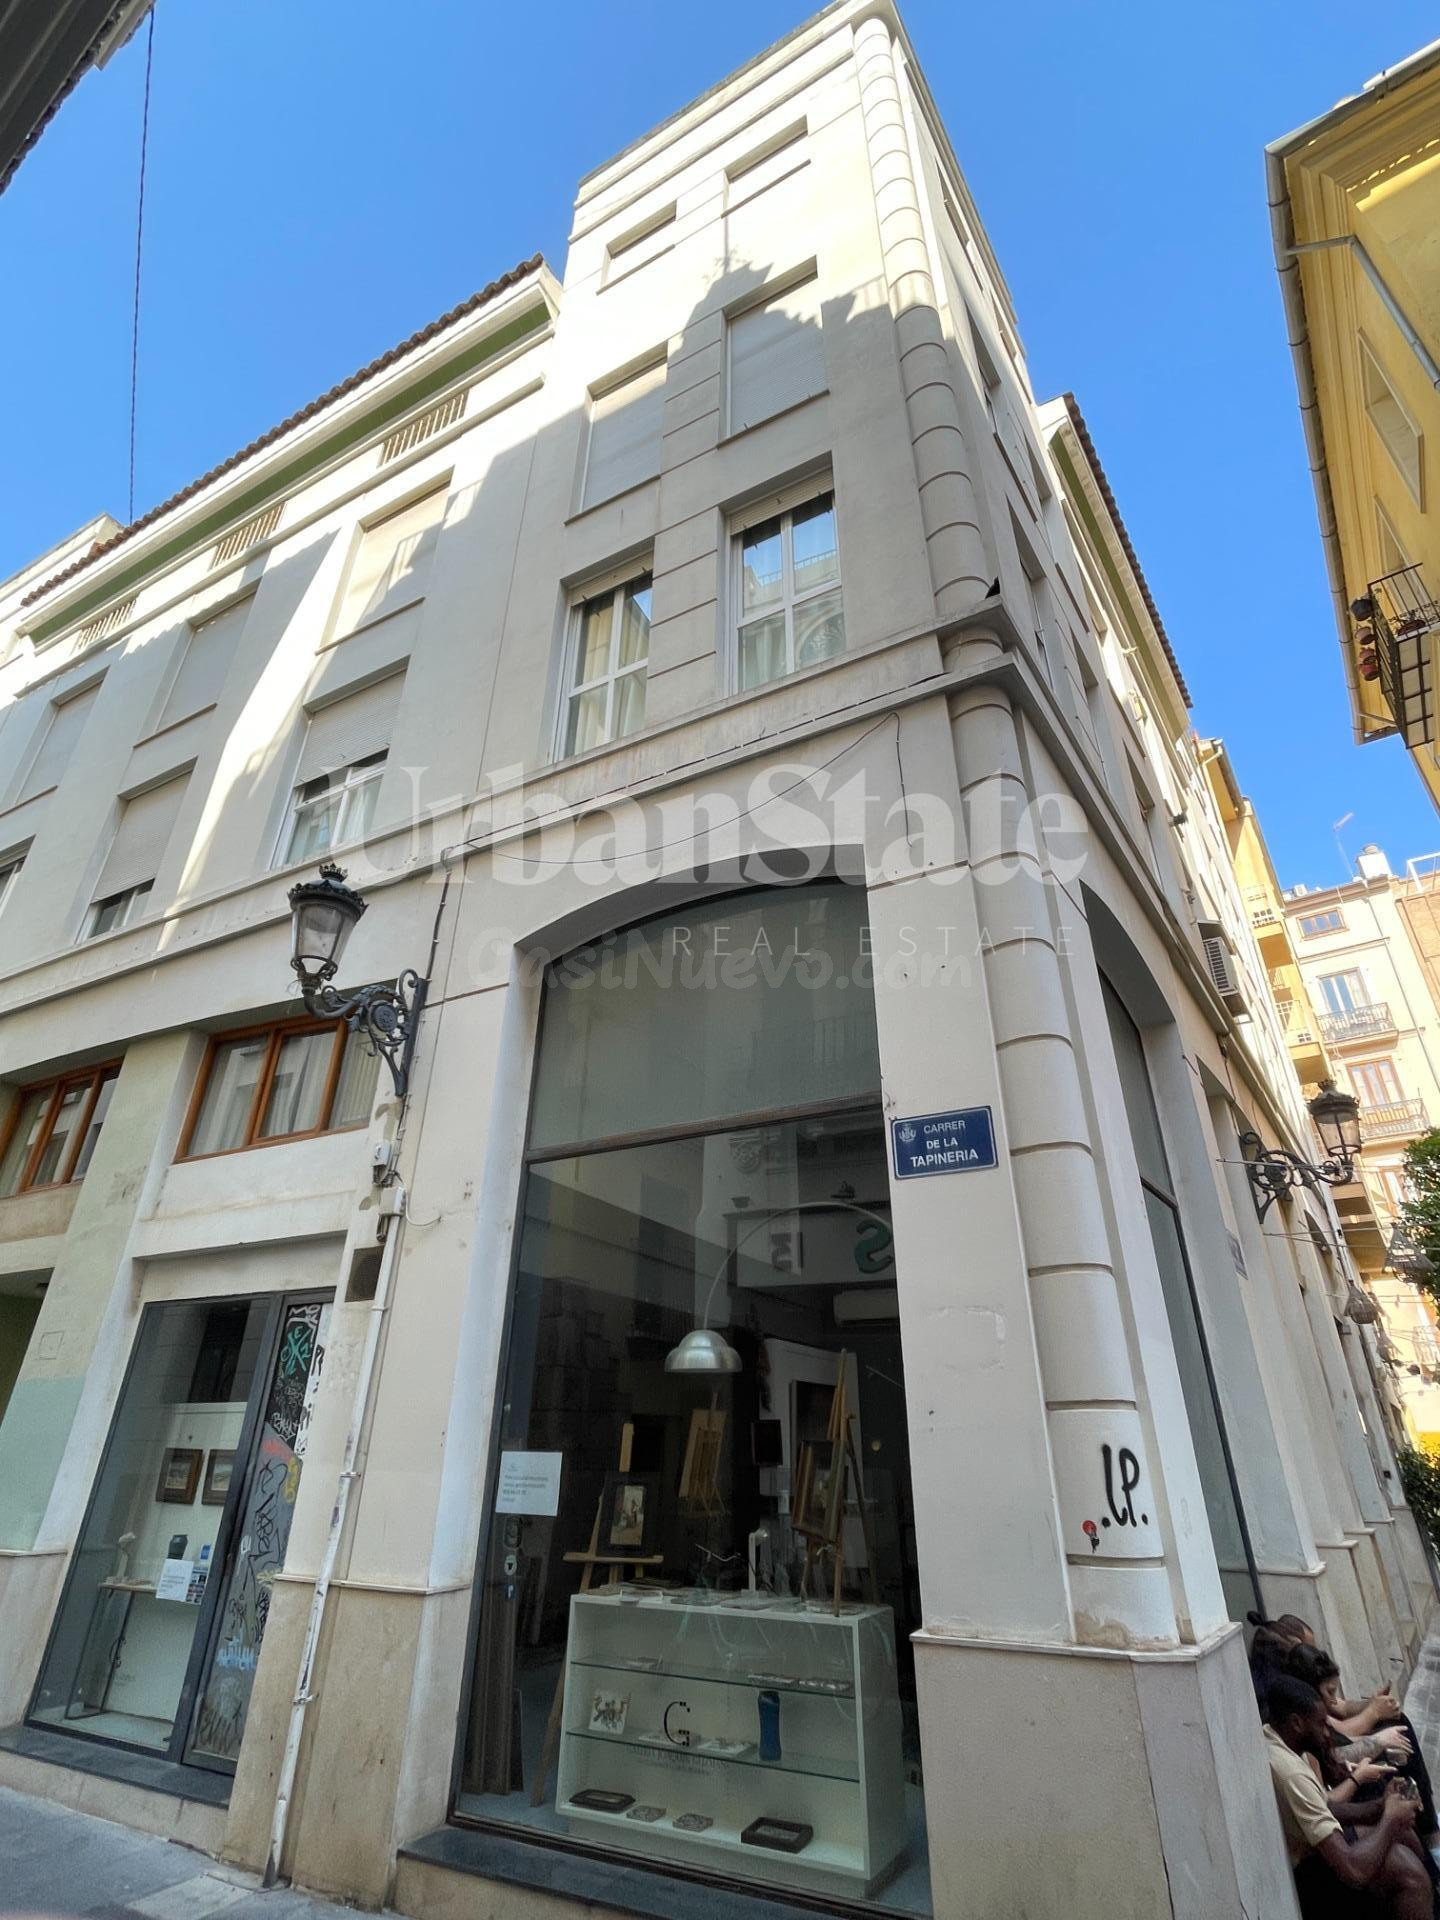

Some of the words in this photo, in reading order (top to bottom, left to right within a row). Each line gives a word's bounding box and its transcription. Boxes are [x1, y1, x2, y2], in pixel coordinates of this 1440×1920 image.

[923, 1120, 967, 1135] CARRER
[926, 1140, 940, 1150] DE
[943, 1137, 959, 1148] LA
[910, 1148, 979, 1168] TAPINERIA
